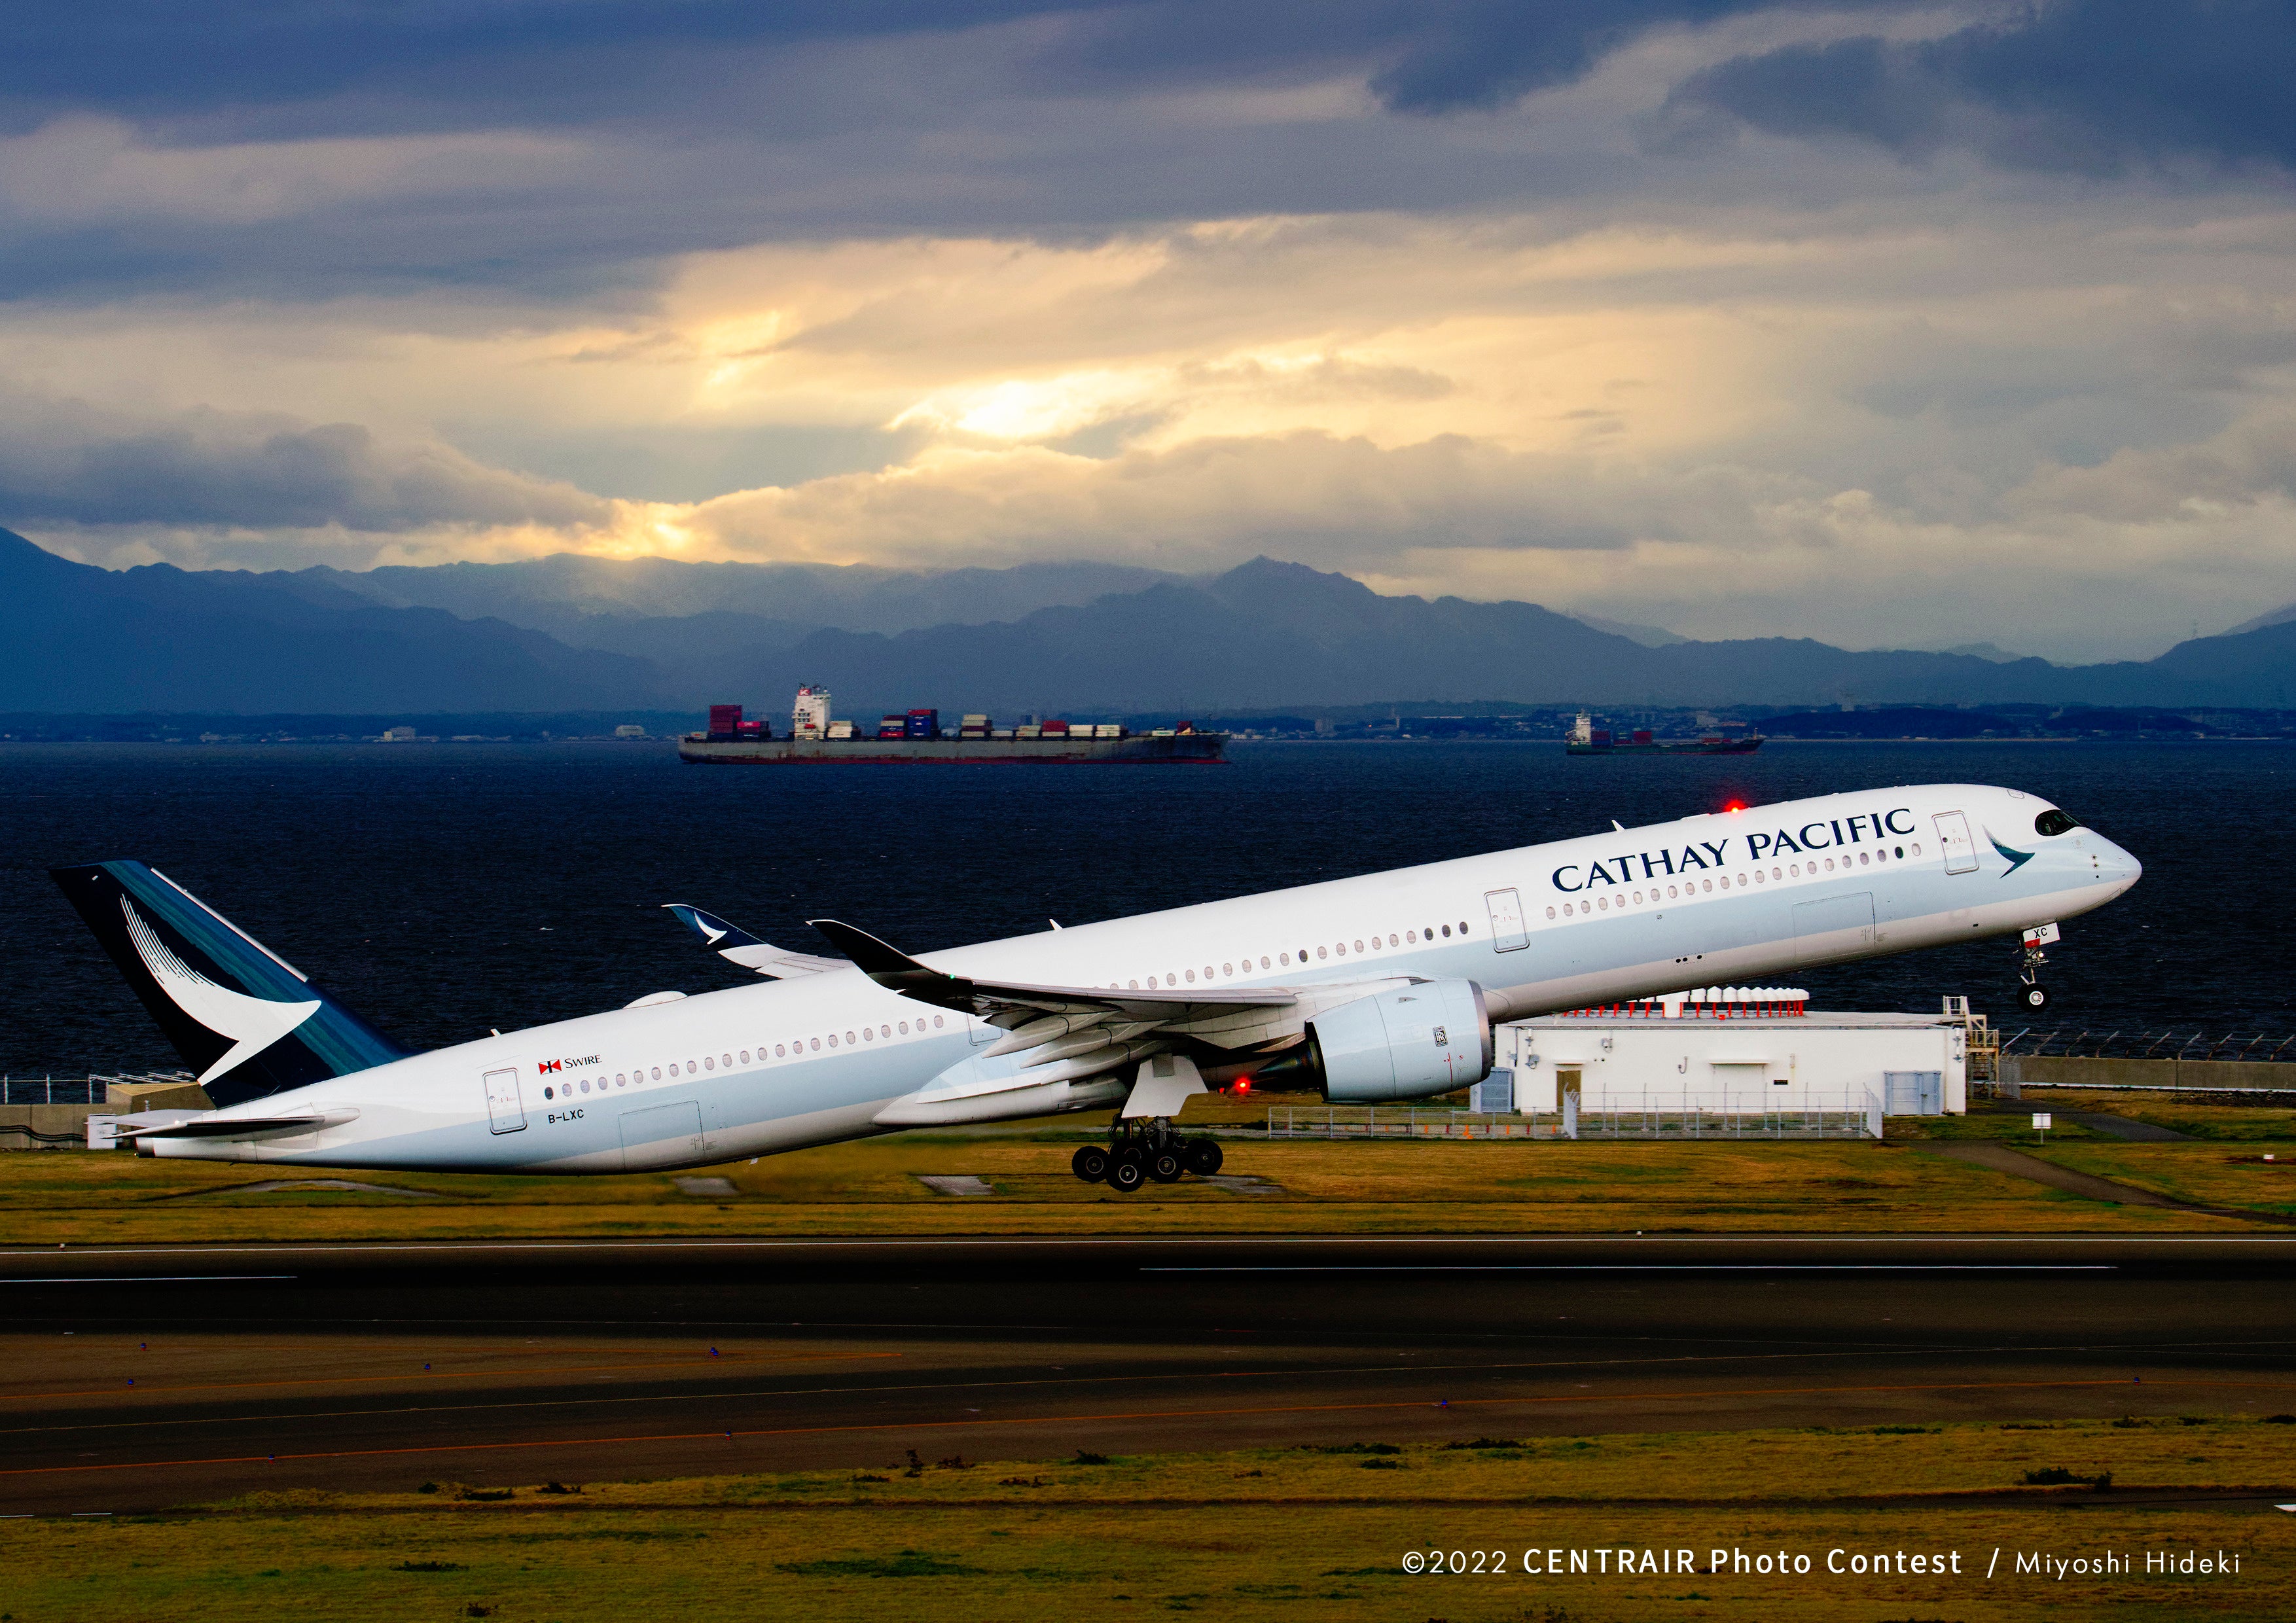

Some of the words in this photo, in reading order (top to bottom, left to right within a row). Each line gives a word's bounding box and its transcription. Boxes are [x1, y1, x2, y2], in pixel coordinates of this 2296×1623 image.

[1552, 838, 1729, 892] CATHAY
[1745, 808, 1915, 861] PACIFIC
[2034, 927, 2048, 938] XC
[548, 1109, 584, 1124] B-LXC
